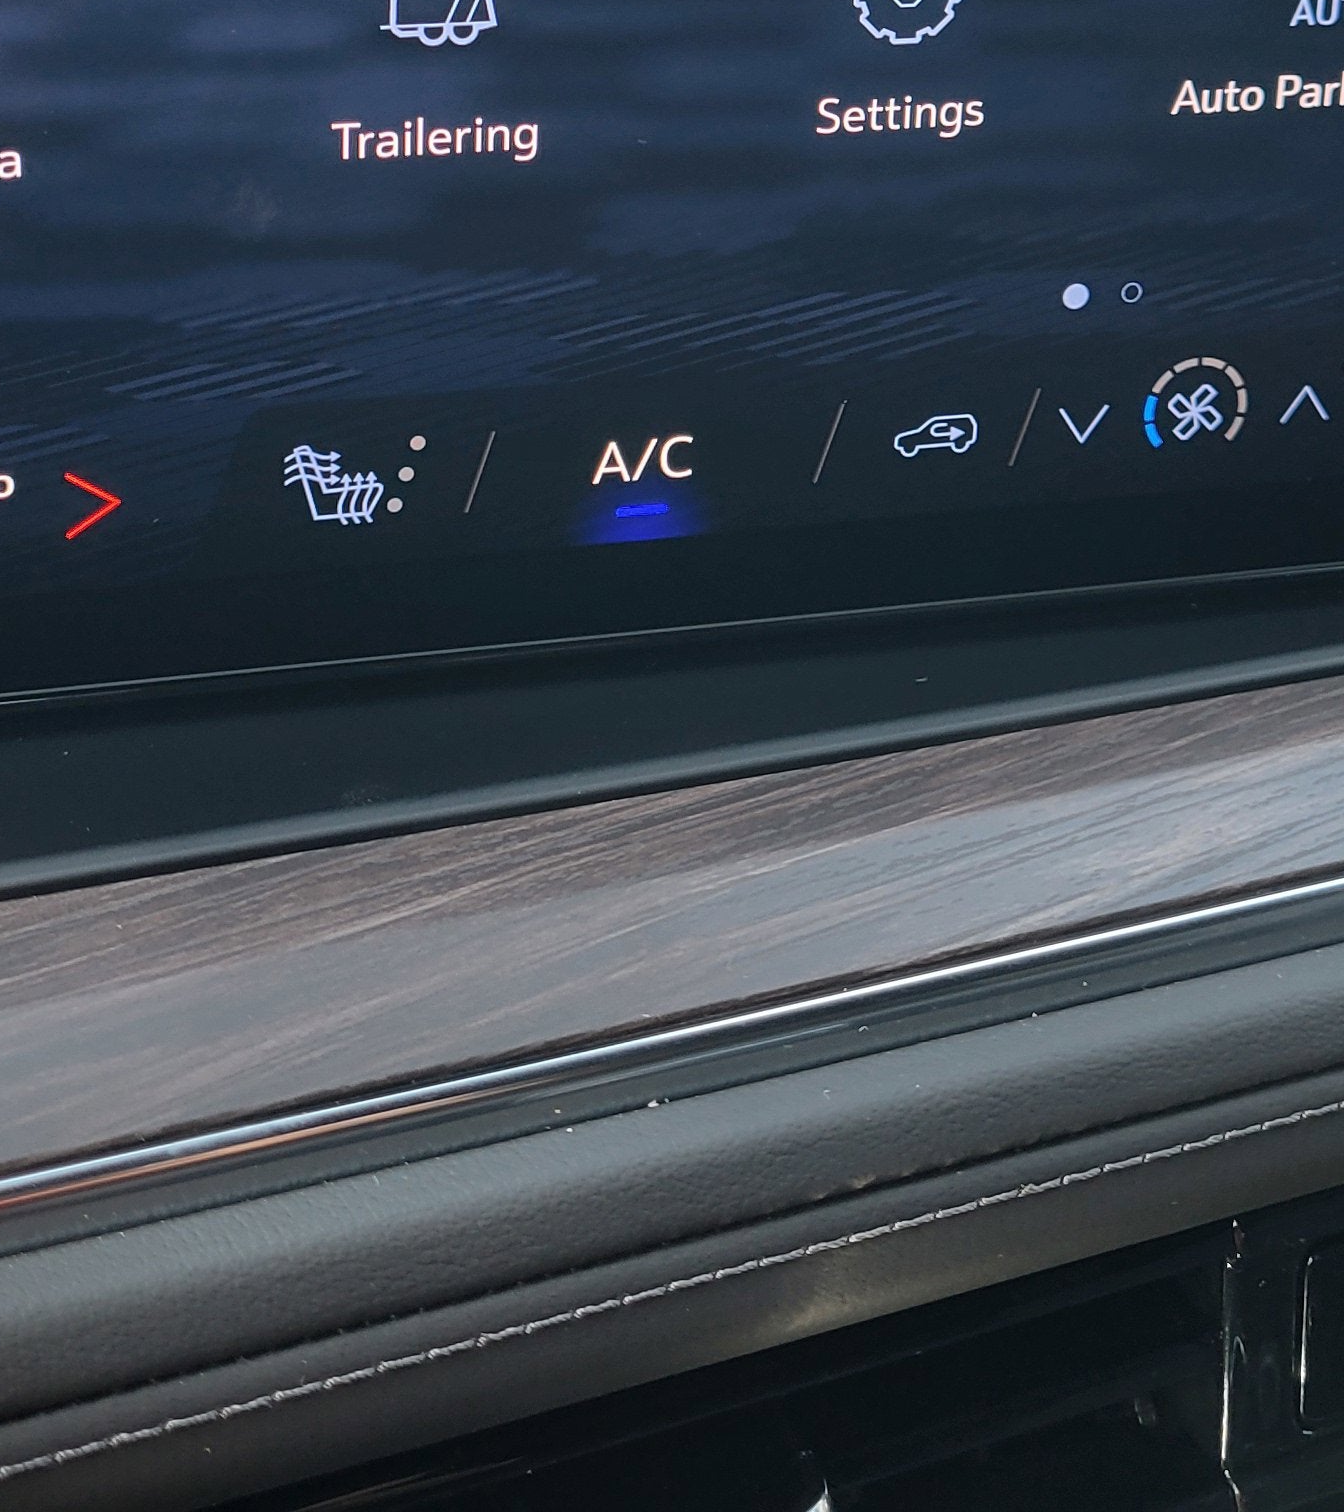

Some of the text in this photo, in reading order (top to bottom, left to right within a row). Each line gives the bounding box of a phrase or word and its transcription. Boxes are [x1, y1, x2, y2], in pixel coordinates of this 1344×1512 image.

[815, 95, 985, 138] Settings
[1170, 79, 1265, 116] Auto
[330, 116, 539, 162] Trailering
[591, 434, 694, 485] A/C
